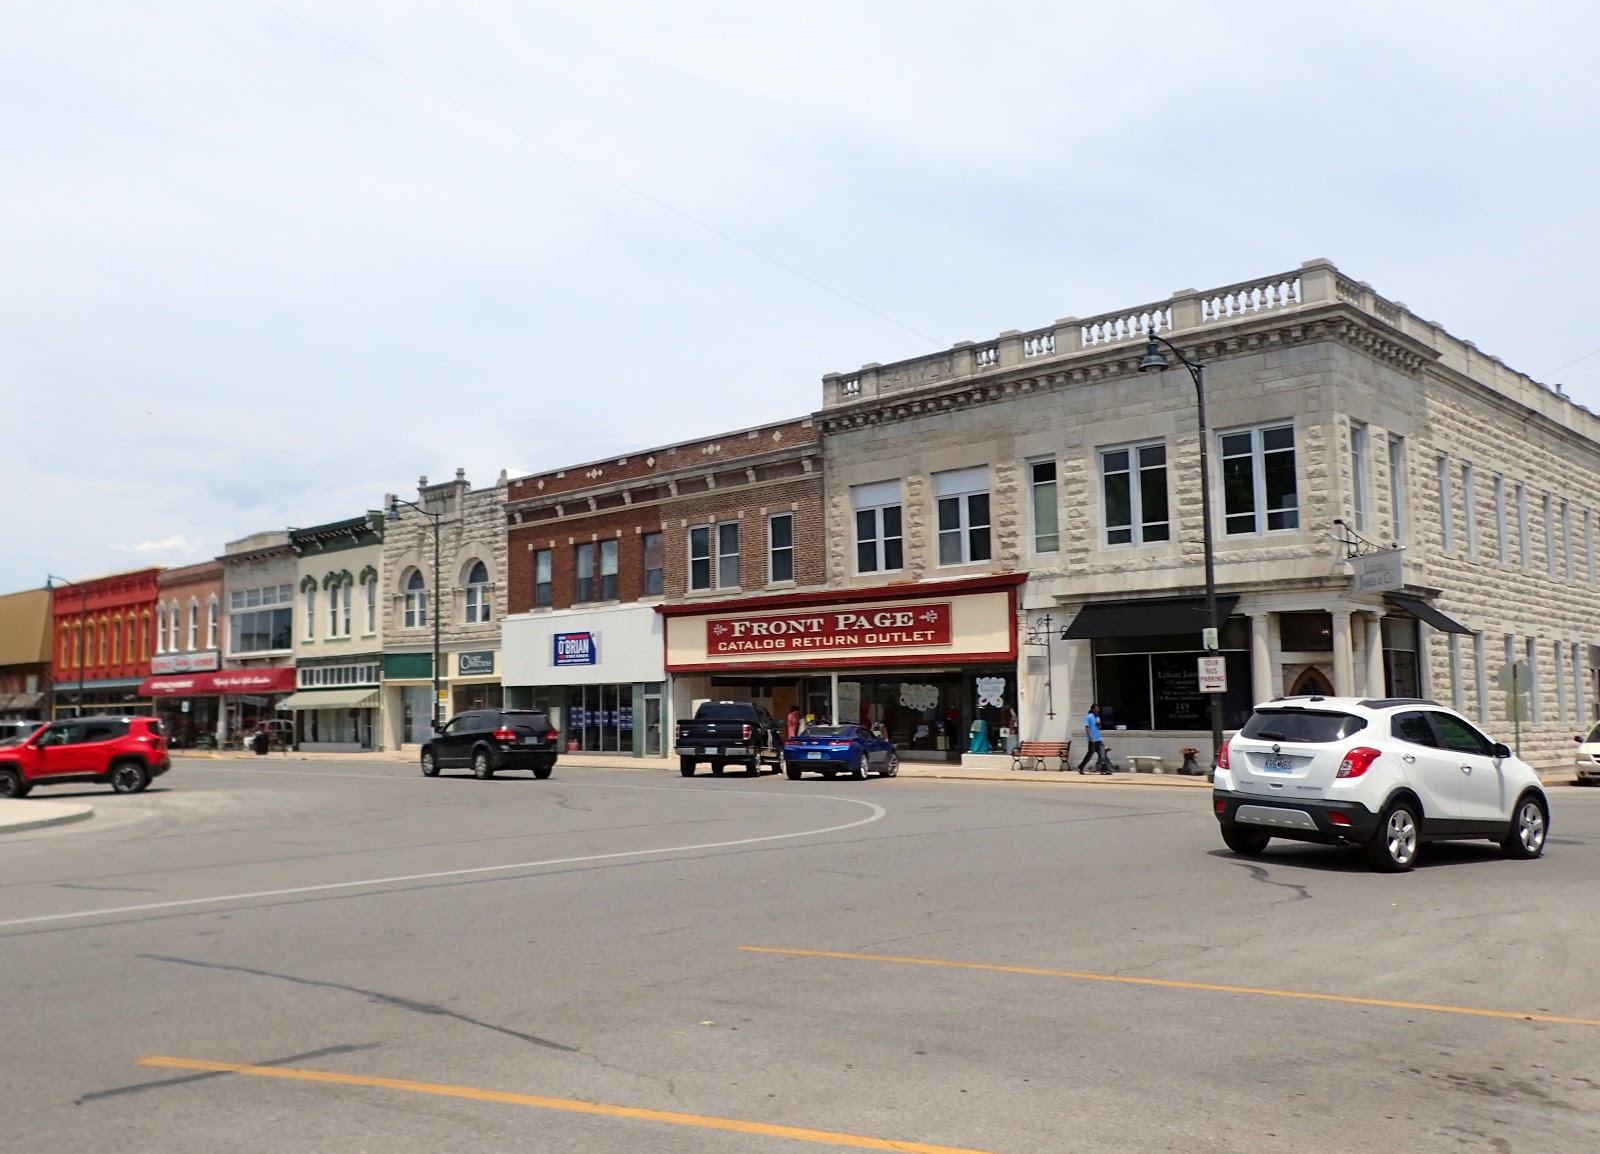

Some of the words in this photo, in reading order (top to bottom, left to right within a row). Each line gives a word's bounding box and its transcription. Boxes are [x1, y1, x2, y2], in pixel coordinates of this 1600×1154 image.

[731, 618, 824, 637] FRONT
[835, 612, 914, 630] PAGE
[558, 639, 589, 655] O'BRIAN
[718, 639, 786, 651] CATALOG
[792, 635, 858, 647] RETURN
[865, 631, 936, 644] OUTLET
